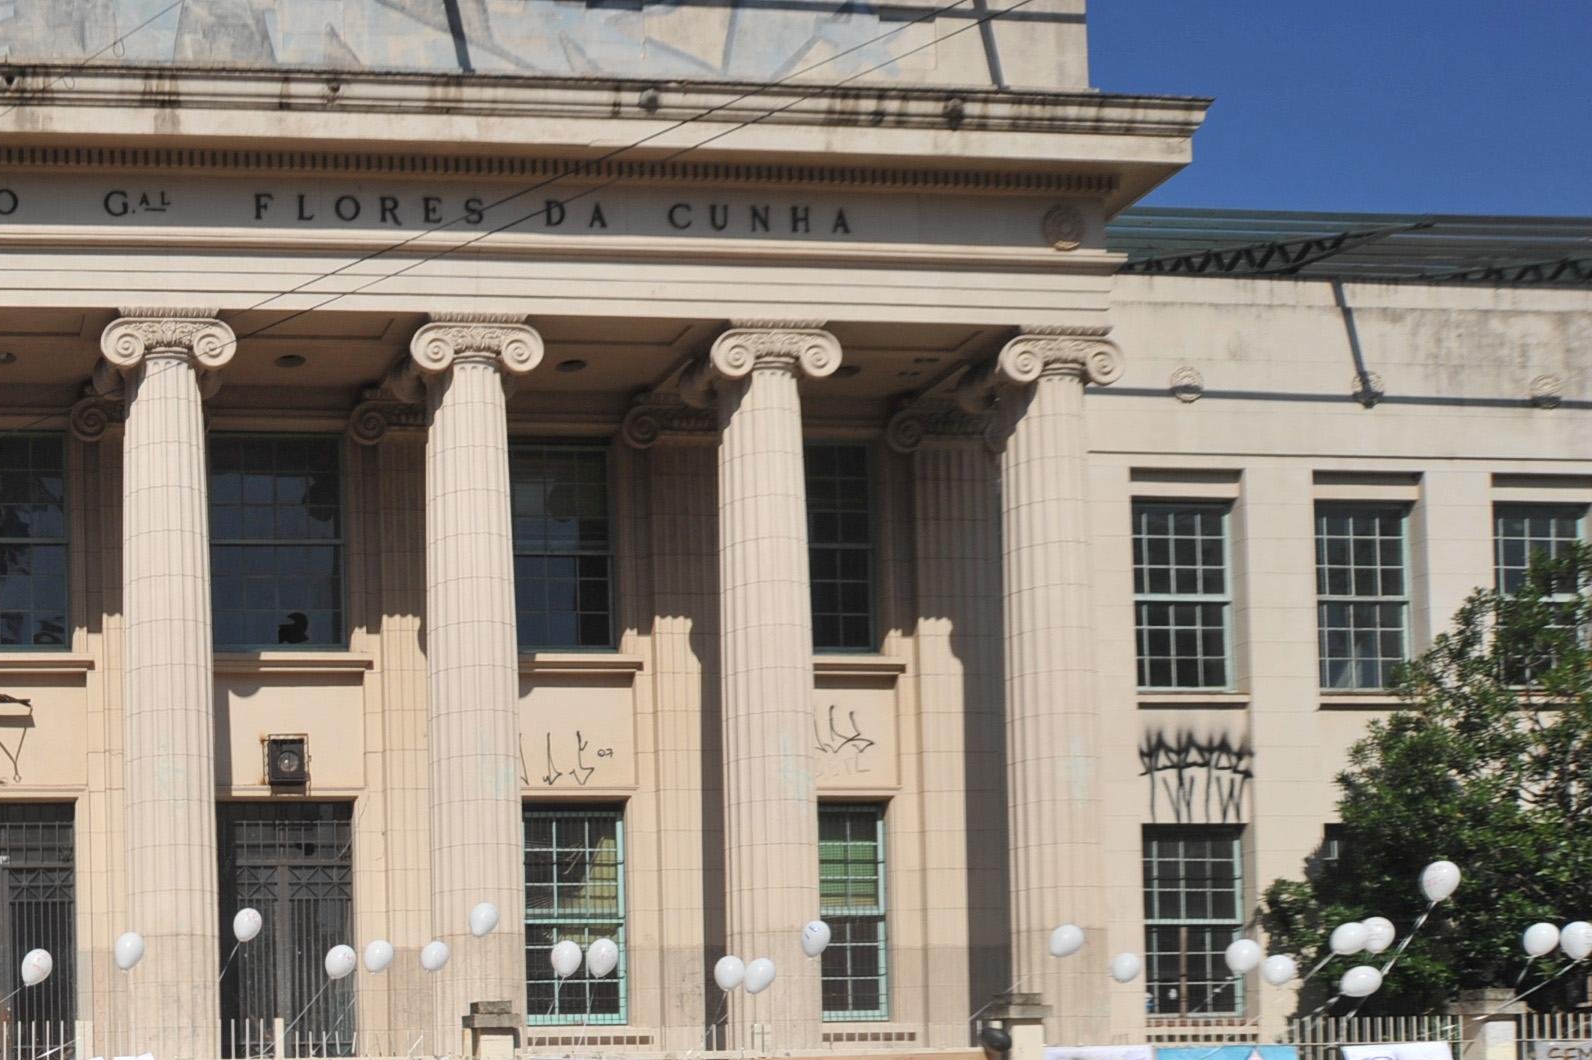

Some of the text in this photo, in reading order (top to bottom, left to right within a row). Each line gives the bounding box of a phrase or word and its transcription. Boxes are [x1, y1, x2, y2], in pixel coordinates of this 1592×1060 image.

[253, 192, 487, 225] FLORES
[544, 198, 609, 229] DA
[667, 203, 852, 235] CUNHA
